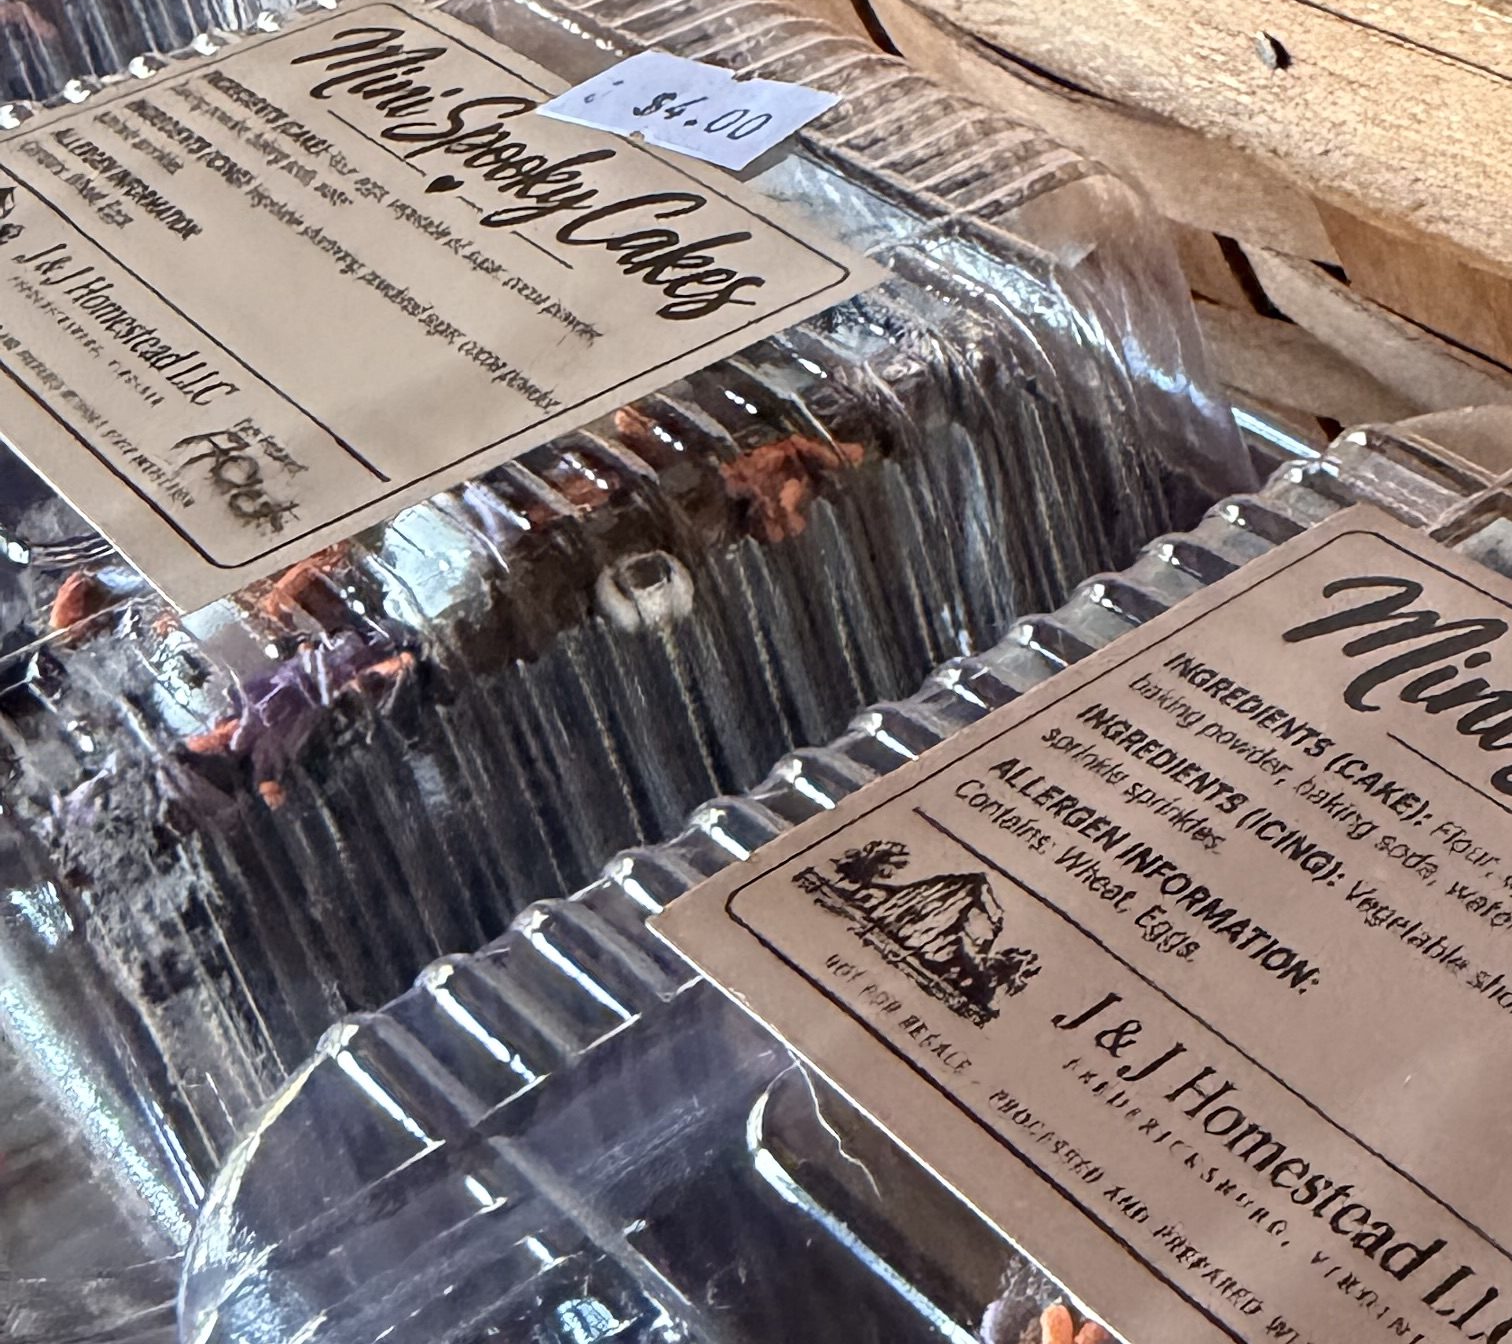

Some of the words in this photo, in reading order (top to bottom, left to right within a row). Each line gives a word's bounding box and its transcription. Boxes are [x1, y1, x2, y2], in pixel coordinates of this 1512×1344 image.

[632, 92, 773, 140] $4.00
[290, 27, 464, 119] Mini
[381, 96, 617, 228] Spooky
[556, 192, 766, 321] Cakes
[12, 243, 67, 264] J
[39, 266, 95, 286] J
[64, 276, 200, 373] Homestead
[165, 361, 241, 406] LLC
[1128, 672, 1206, 729] baking
[1194, 722, 1294, 786] powder,
[1293, 775, 1380, 841] baking
[1374, 835, 1439, 887] soda,
[1162, 652, 1337, 758] INGREDIENTS
[1323, 752, 1433, 827] (CAKE):
[1429, 821, 1501, 878] Flour,
[954, 779, 1056, 855] Contains:
[1075, 703, 1249, 814] INGREDIENTS
[1234, 807, 1346, 887] (ICING):
[1345, 879, 1468, 971] Vegetable
[988, 757, 1132, 853] ALLERGEN
[1114, 842, 1320, 995] INFORMATION:
[1050, 992, 1123, 1031] J
[1094, 1019, 1143, 1059] &
[1116, 1041, 1188, 1082] J
[898, 1014, 972, 1074] RESALE
[1103, 1186, 1150, 1224] AND
[1152, 1224, 1264, 1315] PREPARED
[1163, 1066, 1448, 1282] Homestead
